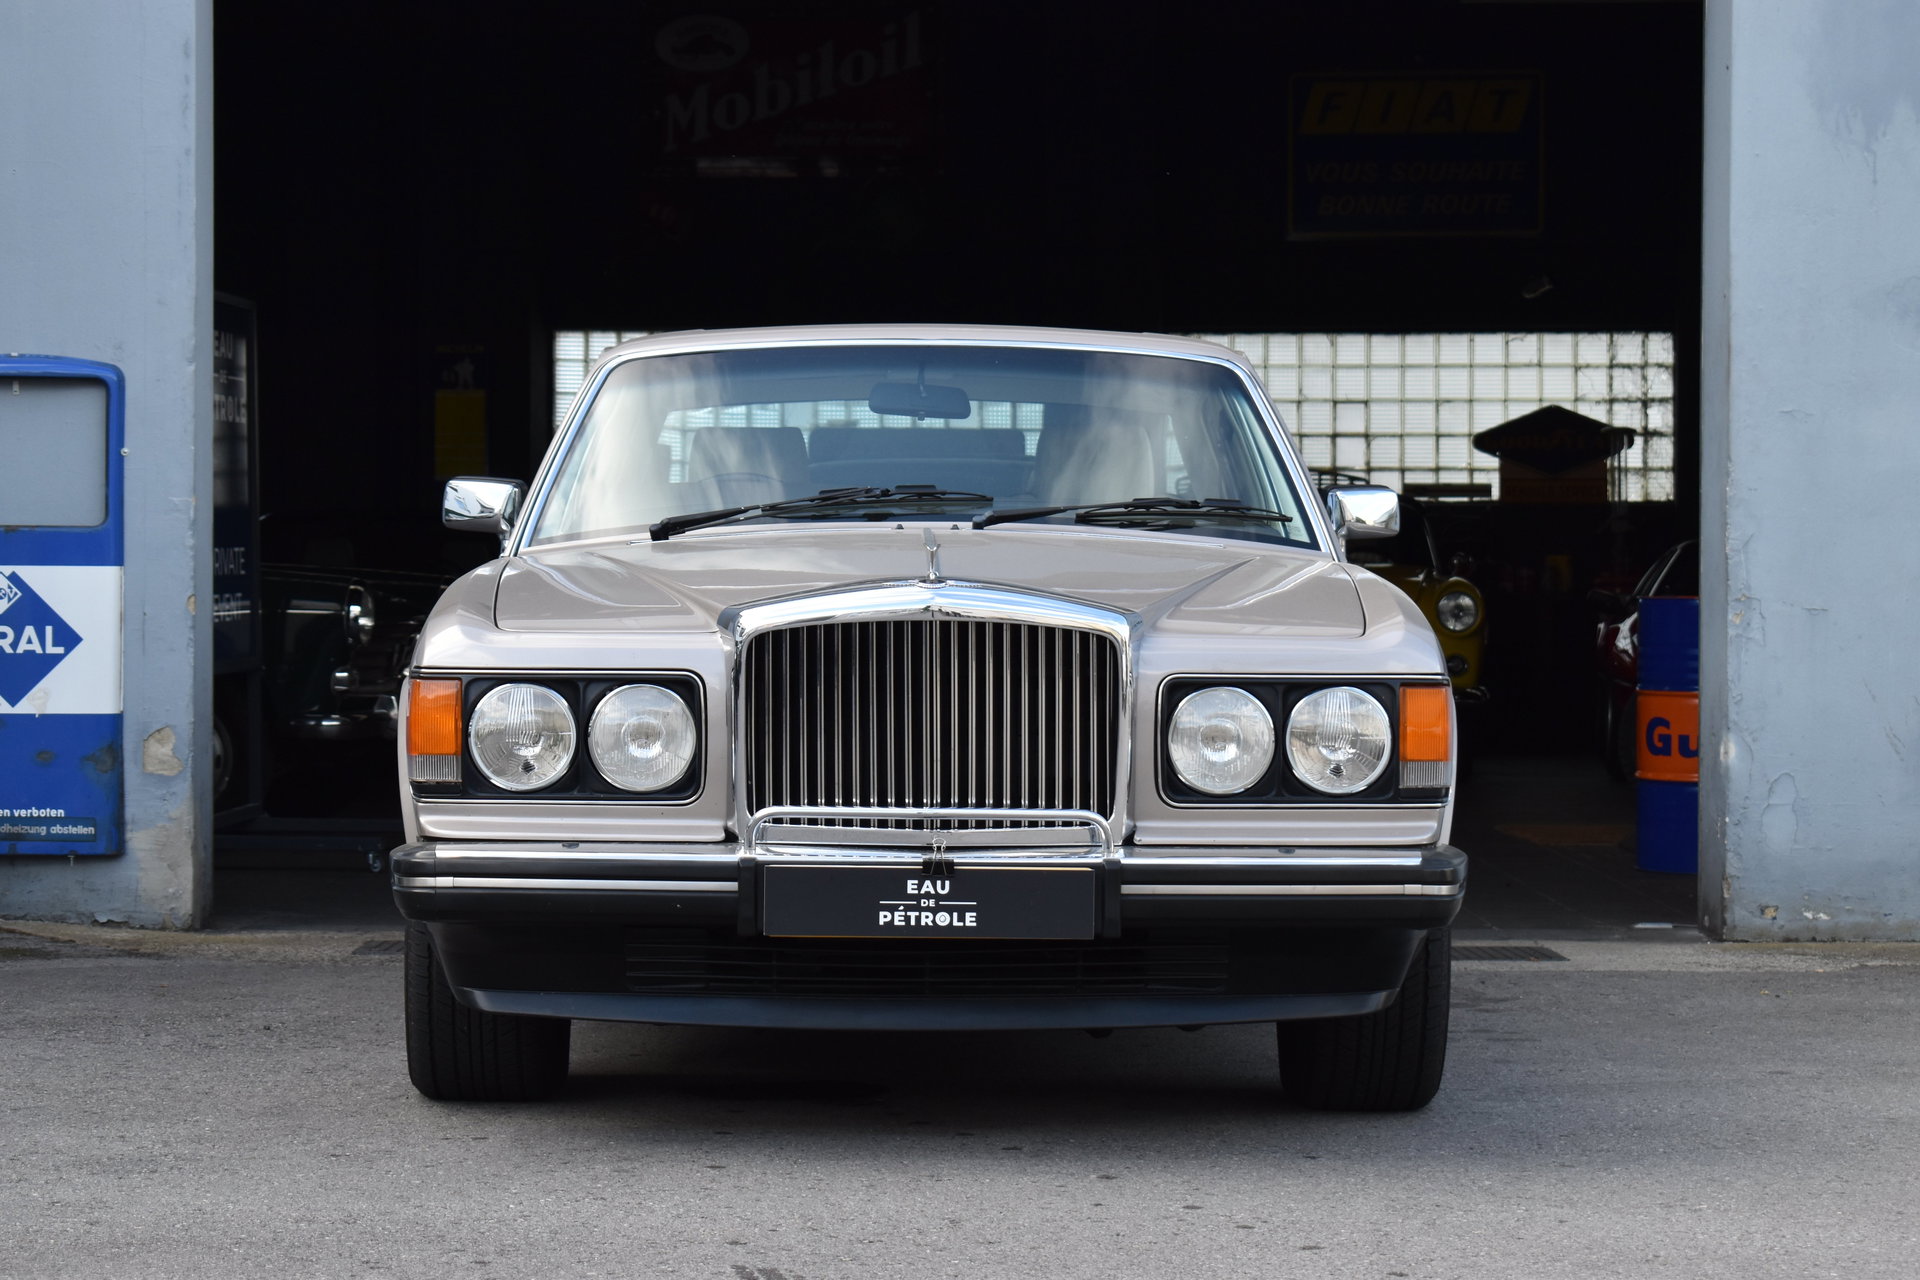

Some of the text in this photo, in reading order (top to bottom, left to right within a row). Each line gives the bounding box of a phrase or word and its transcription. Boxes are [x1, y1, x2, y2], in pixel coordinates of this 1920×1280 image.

[664, 10, 922, 153] Mobiloil
[1315, 88, 1522, 125] FIAT
[1305, 159, 1528, 183] VOUS SOUHAITE
[1316, 193, 1513, 217] BONNE ROUTE
[213, 547, 246, 577] RIVATE
[0, 625, 65, 654] RAL
[1646, 717, 1699, 758] Gu
[13, 806, 65, 817] verboten
[0, 823, 95, 836] dheizung abstellen
[906, 879, 950, 895] EAU
[921, 898, 935, 907] DE
[879, 905, 977, 927] PÉTROLE
